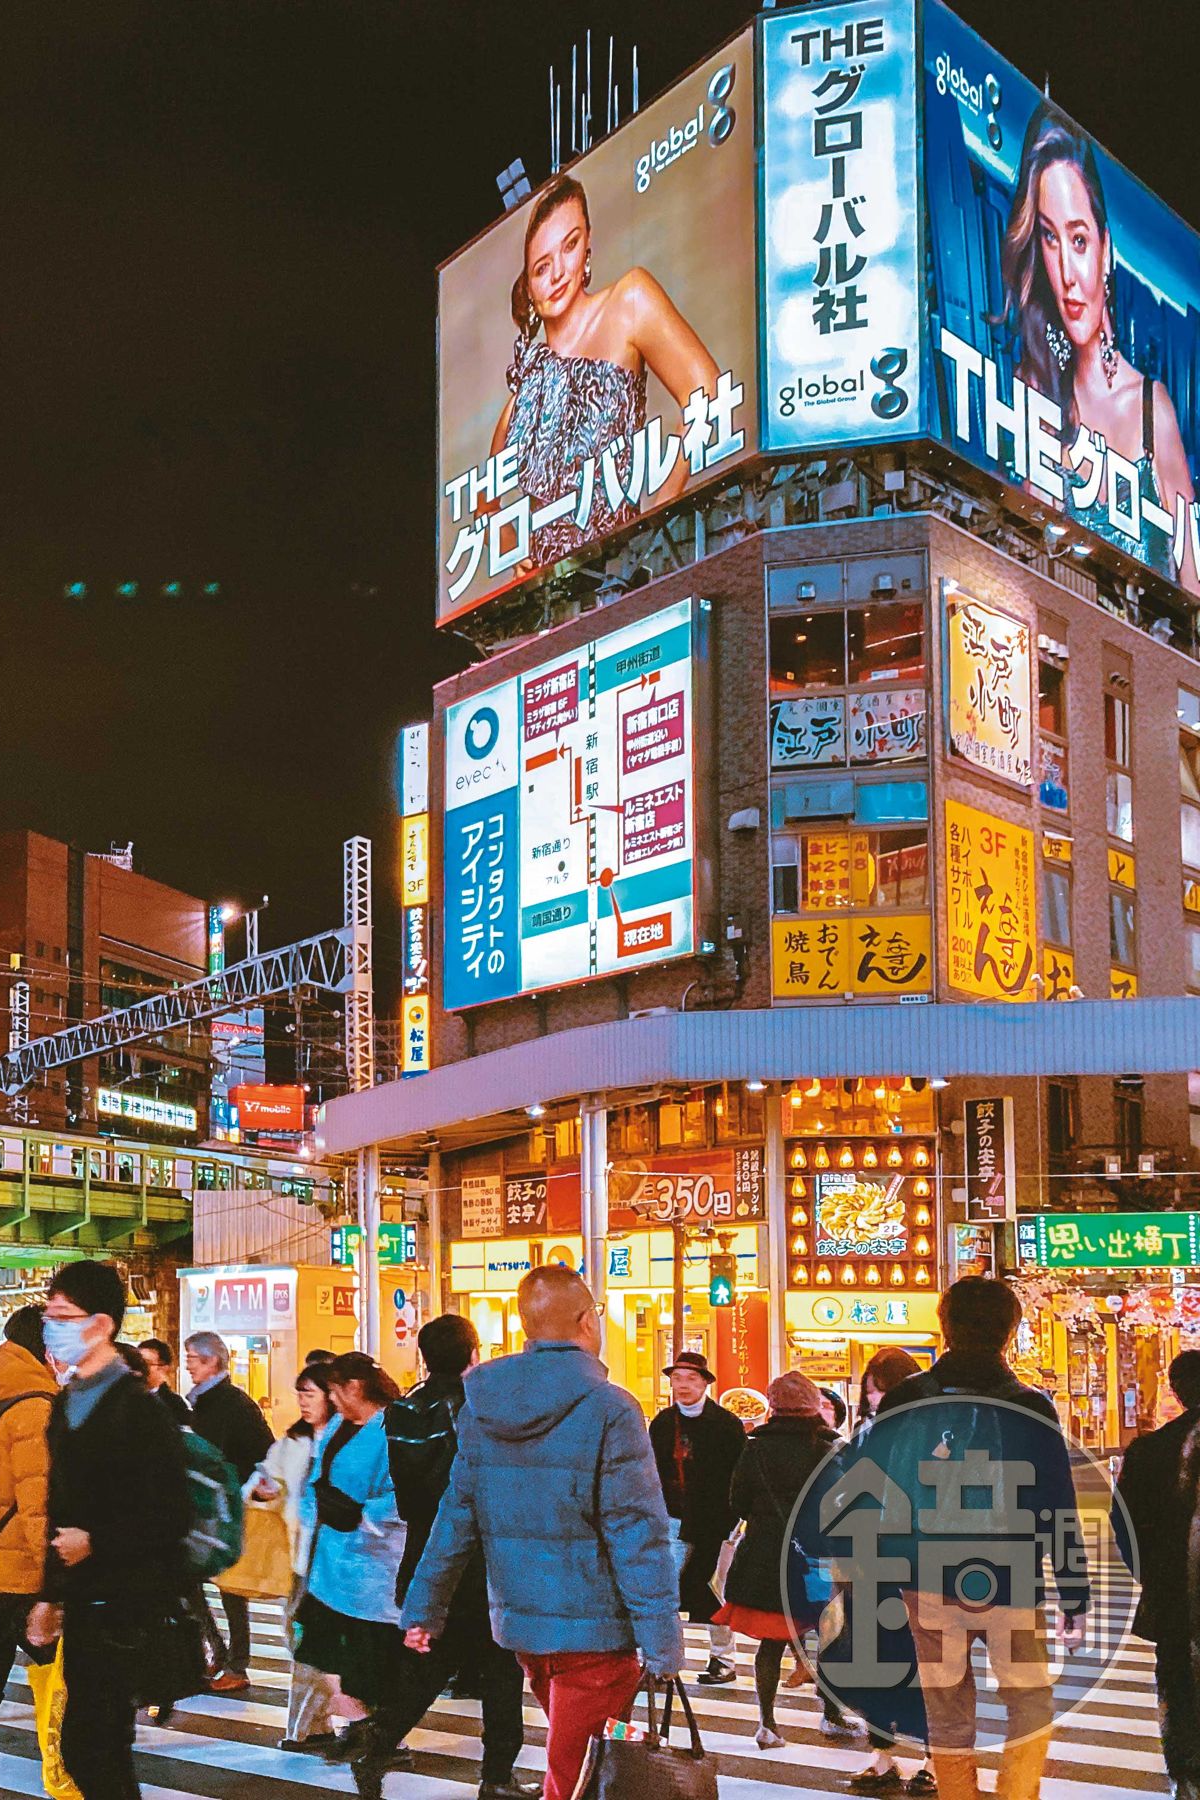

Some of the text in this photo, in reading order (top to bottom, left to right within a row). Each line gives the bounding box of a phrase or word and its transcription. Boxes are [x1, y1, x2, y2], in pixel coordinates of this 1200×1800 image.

[792, 18, 884, 66] THE
[936, 55, 982, 110] global
[636, 104, 704, 193] global
[810, 64, 868, 334] グローバル社
[779, 370, 864, 417] global
[941, 327, 1064, 501] THE
[445, 442, 519, 523] THE
[445, 370, 745, 602] グローバル社
[616, 646, 661, 674] 甲州街道
[775, 717, 842, 759] 江戸
[586, 732, 599, 800] 新宿駅
[625, 784, 683, 817] ルミネエスト
[625, 810, 656, 835] 新宿店
[531, 837, 570, 859] 新宿通り
[810, 842, 867, 855] 生ビール
[980, 827, 1006, 858] 3F
[408, 879, 425, 892] 3F
[488, 814, 505, 974] コンタクトの
[546, 872, 569, 885] アルタ
[950, 822, 961, 928] 各種サワー
[461, 821, 484, 978] アイシティ
[531, 906, 572, 928] 靖国通り
[623, 922, 663, 947] 現在地
[952, 936, 973, 955] 200
[784, 930, 810, 984] 焼鳥
[817, 924, 840, 990] おでん
[410, 1028, 425, 1062] 松屋
[976, 1102, 995, 1183] 餃子の安亭
[742, 1151, 750, 1192] 480円
[507, 1182, 546, 1202] 餃子の
[656, 1175, 731, 1218] 350円
[507, 1204, 536, 1223] 安亭
[816, 1238, 907, 1256] 餃子の安亭
[1049, 1223, 1187, 1259] 思い出横丁
[218, 1284, 263, 1311] ATM
[335, 1293, 353, 1305] AT
